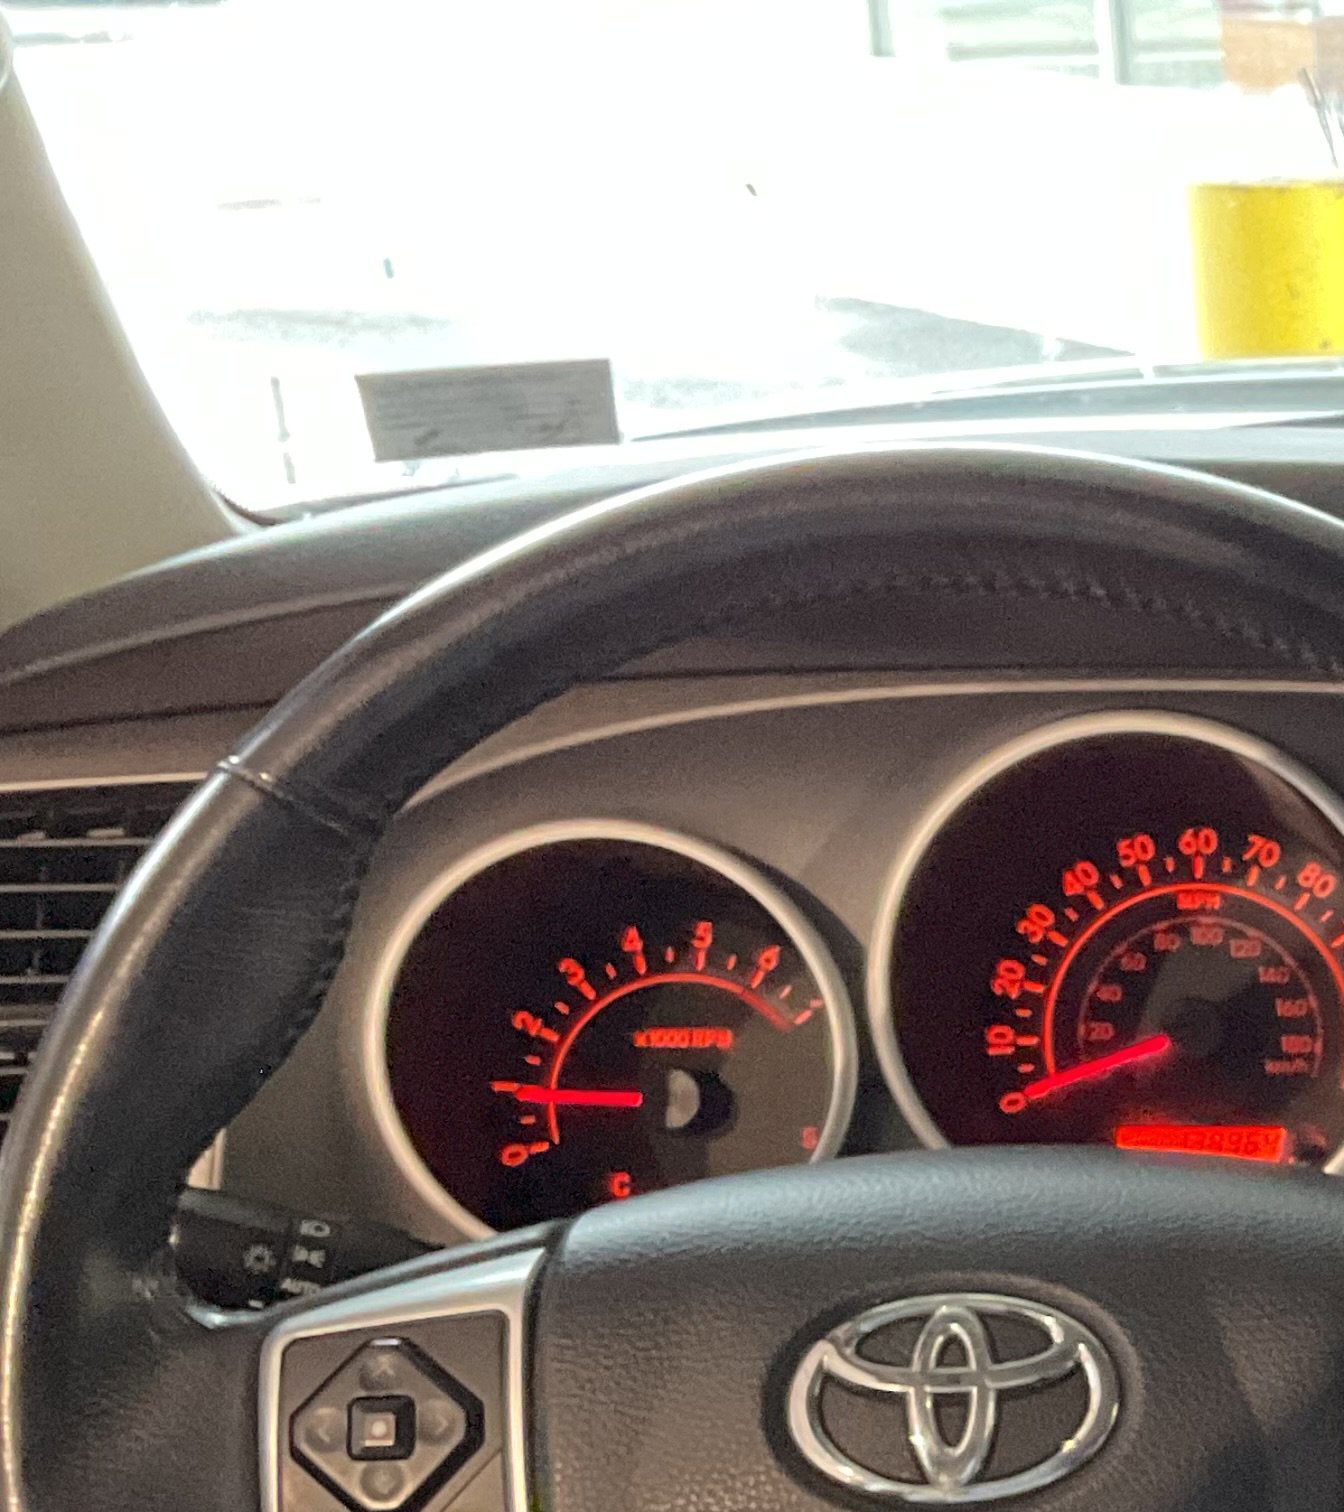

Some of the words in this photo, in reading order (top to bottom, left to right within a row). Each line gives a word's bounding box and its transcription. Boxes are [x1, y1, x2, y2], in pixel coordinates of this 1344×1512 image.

[1117, 833, 1155, 867] 50
[1178, 827, 1218, 855] 60
[1242, 834, 1281, 868] 70
[1062, 860, 1099, 896] 40
[1297, 862, 1336, 898] 80
[691, 921, 712, 949] 5
[1015, 903, 1055, 943] 30
[621, 926, 643, 951] 4
[558, 958, 585, 985] 3
[757, 946, 781, 971] 6
[991, 960, 1025, 999] 20
[511, 1010, 542, 1035] 2
[985, 1024, 1015, 1056] 10
[999, 1092, 1027, 1113] 0
[501, 1143, 528, 1167] 0
[611, 1171, 631, 1197] C
